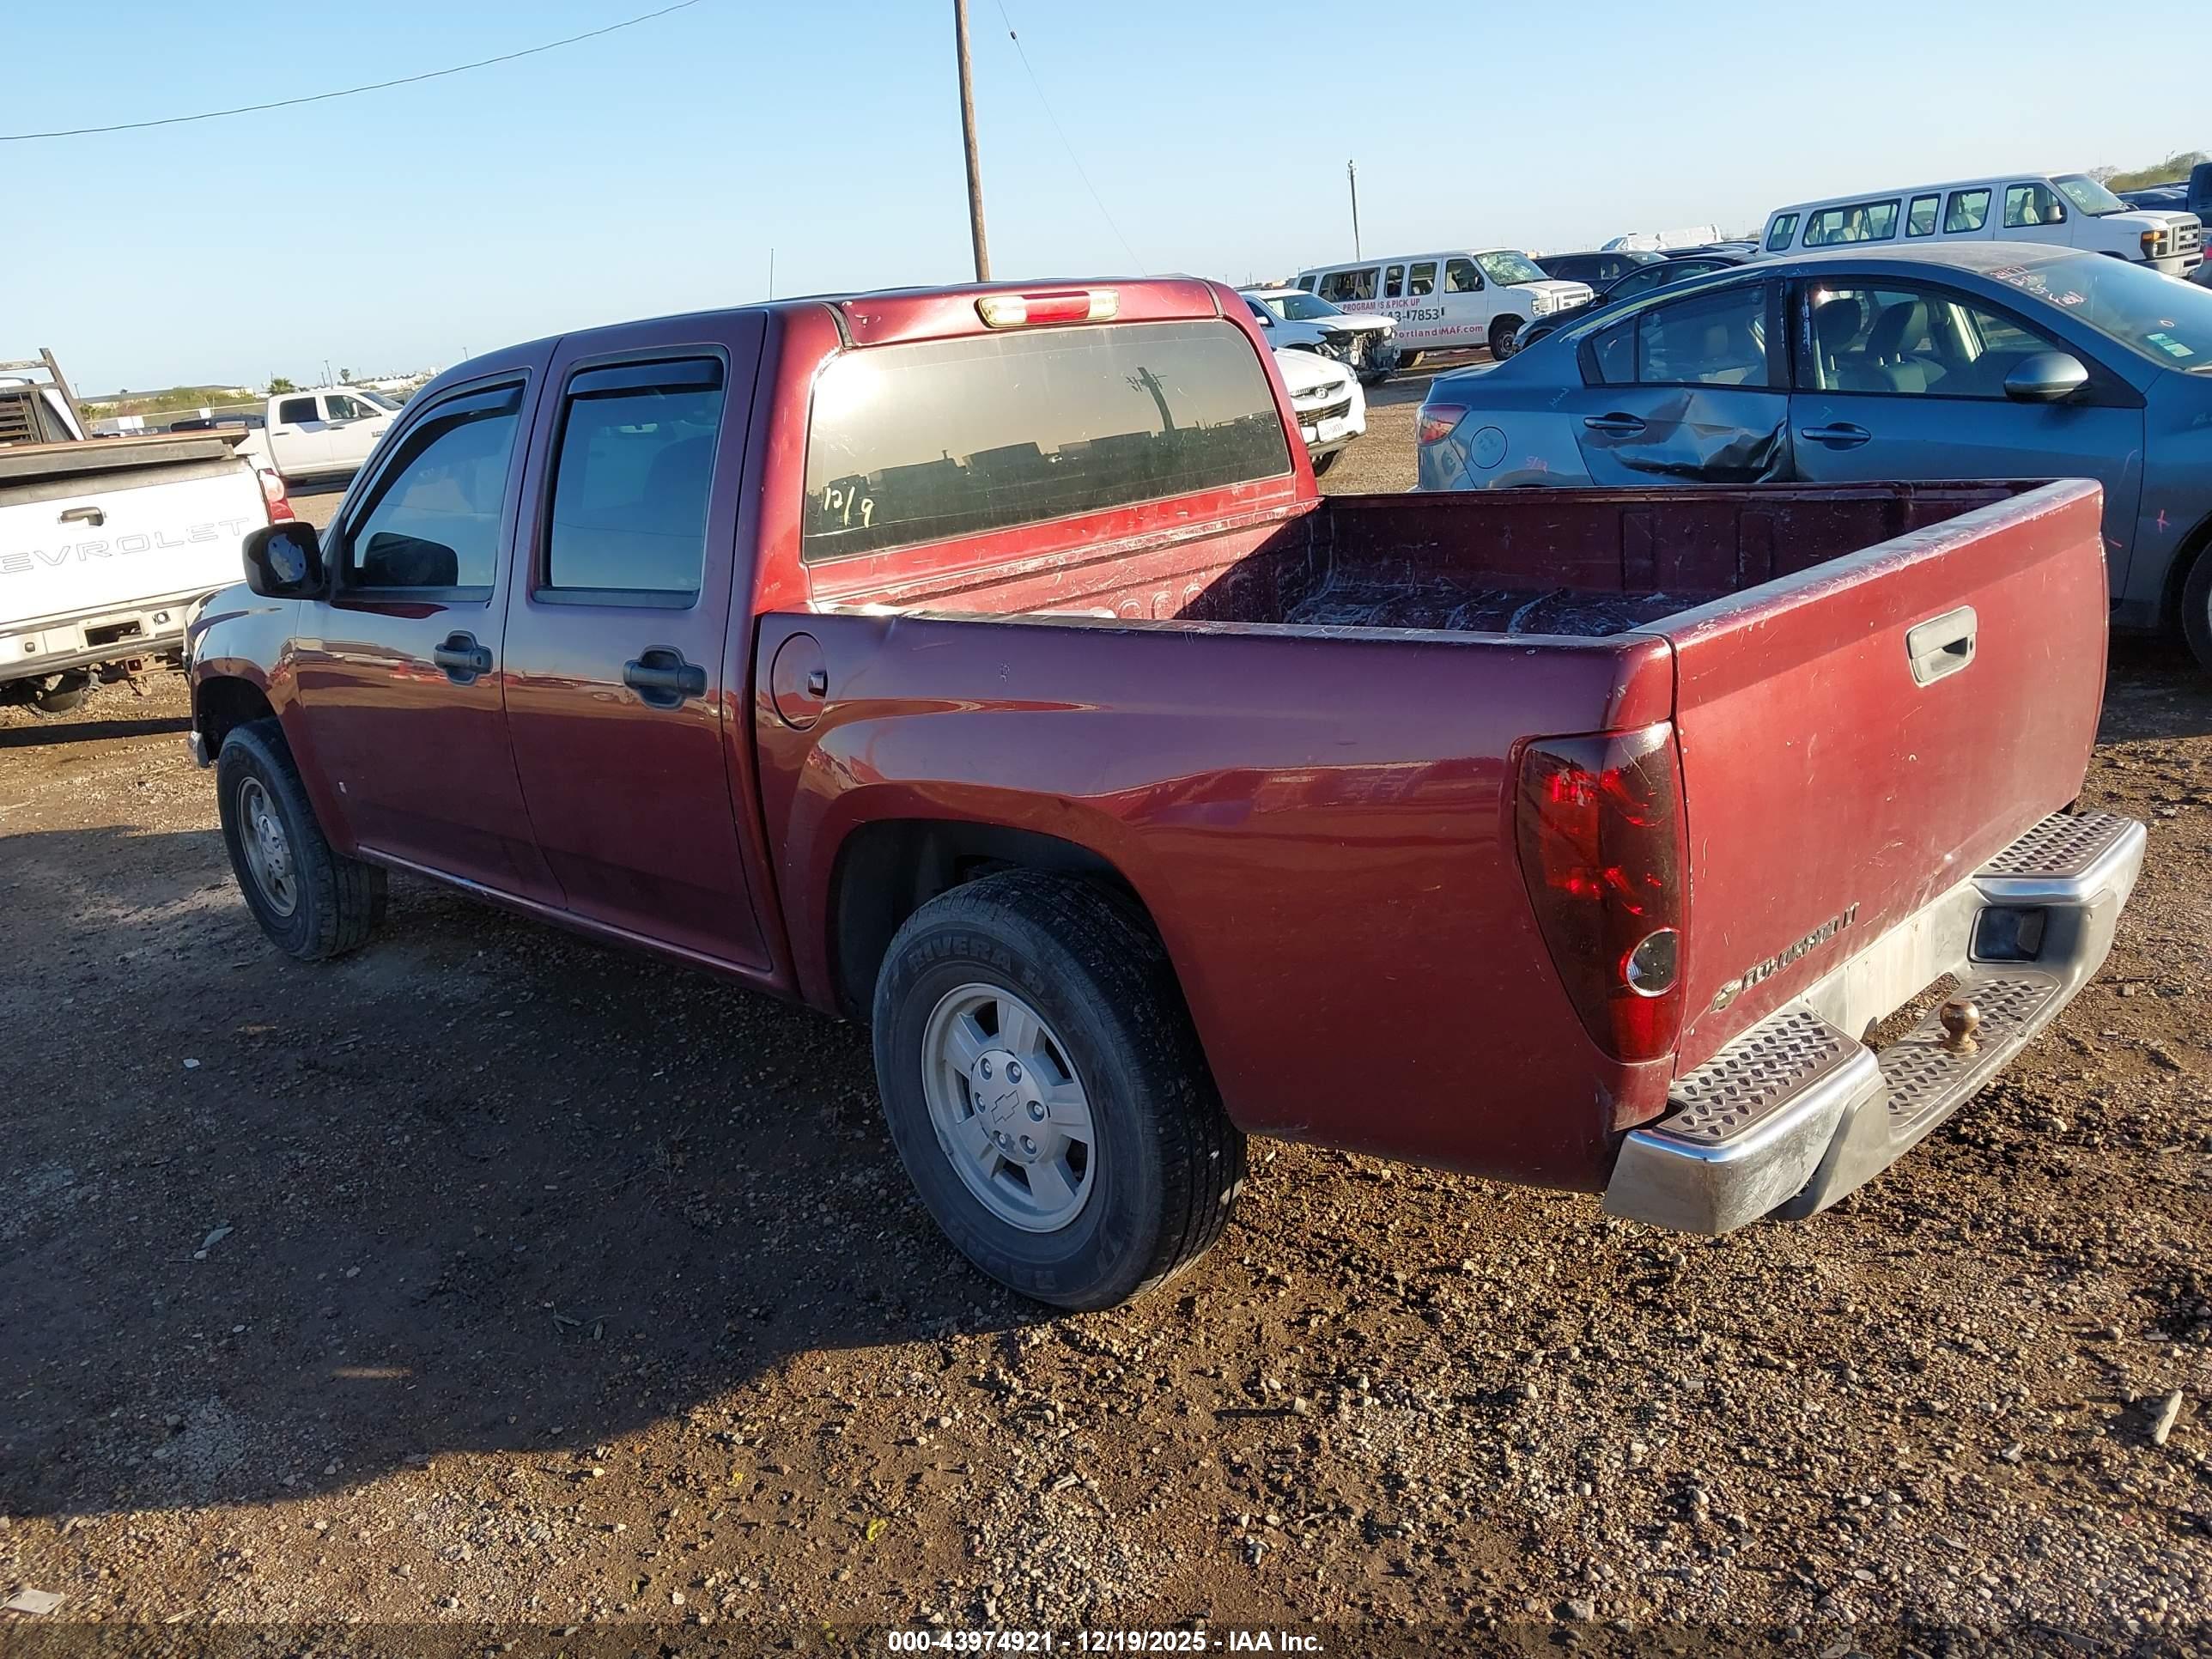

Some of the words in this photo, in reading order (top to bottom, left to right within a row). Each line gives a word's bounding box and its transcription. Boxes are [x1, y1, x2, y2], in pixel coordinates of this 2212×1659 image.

[1392, 299, 1408, 308] PICK
[1411, 298, 1420, 307] UP
[824, 486, 874, 528] 12/9
